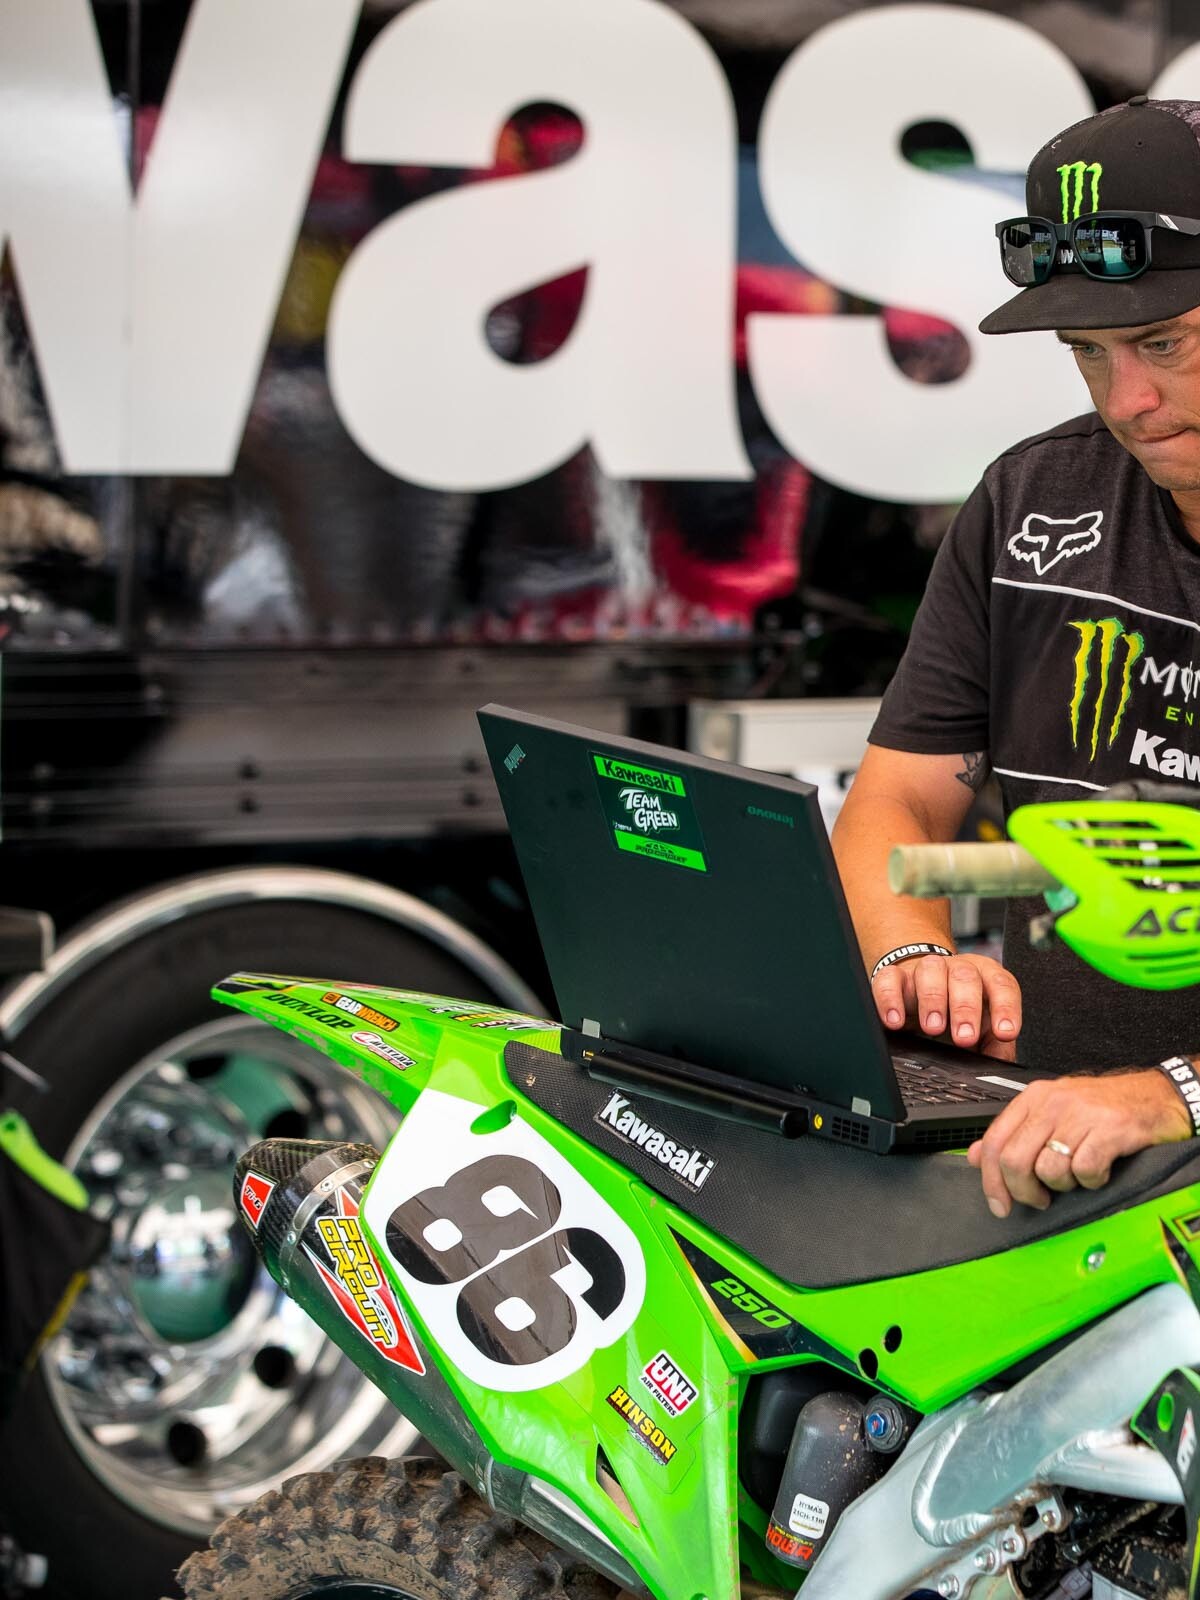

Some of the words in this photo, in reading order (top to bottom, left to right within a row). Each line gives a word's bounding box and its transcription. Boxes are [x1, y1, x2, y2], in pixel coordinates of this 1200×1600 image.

[602, 759, 678, 793] Kawasaki
[620, 788, 662, 811] TEAM
[634, 808, 678, 832] GREEN
[262, 993, 356, 1029] DUNLOP
[600, 1093, 714, 1188] Kawasaki
[337, 1218, 380, 1287] PRO
[385, 1154, 626, 1366] 86
[317, 1218, 392, 1347] CIRCUIT
[710, 1278, 792, 1329] 250
[641, 1376, 655, 1390] AIR
[652, 1388, 677, 1417] FILTERS
[645, 1353, 697, 1412] UNI
[609, 1386, 677, 1460] HINSON
